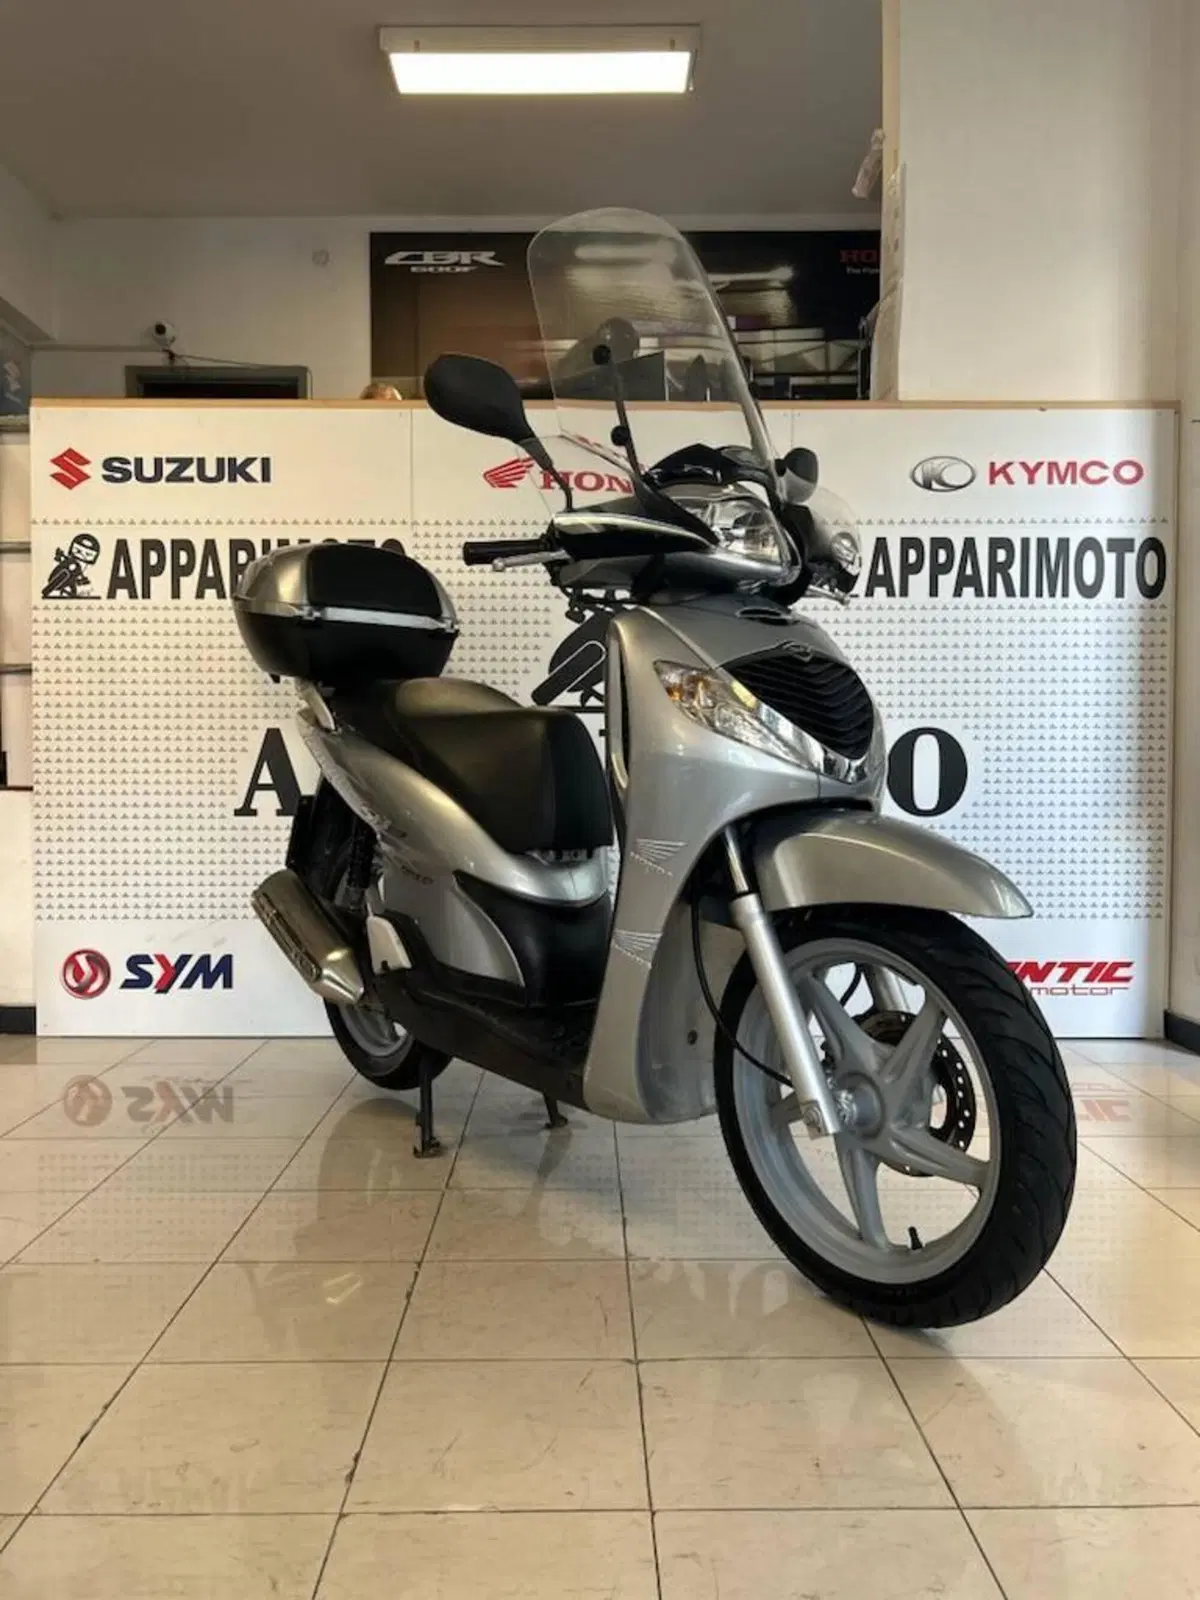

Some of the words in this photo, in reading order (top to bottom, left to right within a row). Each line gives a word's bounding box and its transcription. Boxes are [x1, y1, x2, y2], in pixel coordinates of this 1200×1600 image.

[384, 250, 506, 266] CBR
[101, 456, 271, 483] SUZUKI
[988, 460, 1144, 486] KYMCO
[864, 537, 1167, 600] APPARIMOTO
[119, 954, 234, 994] SYM
[1030, 984, 1129, 996] motor
